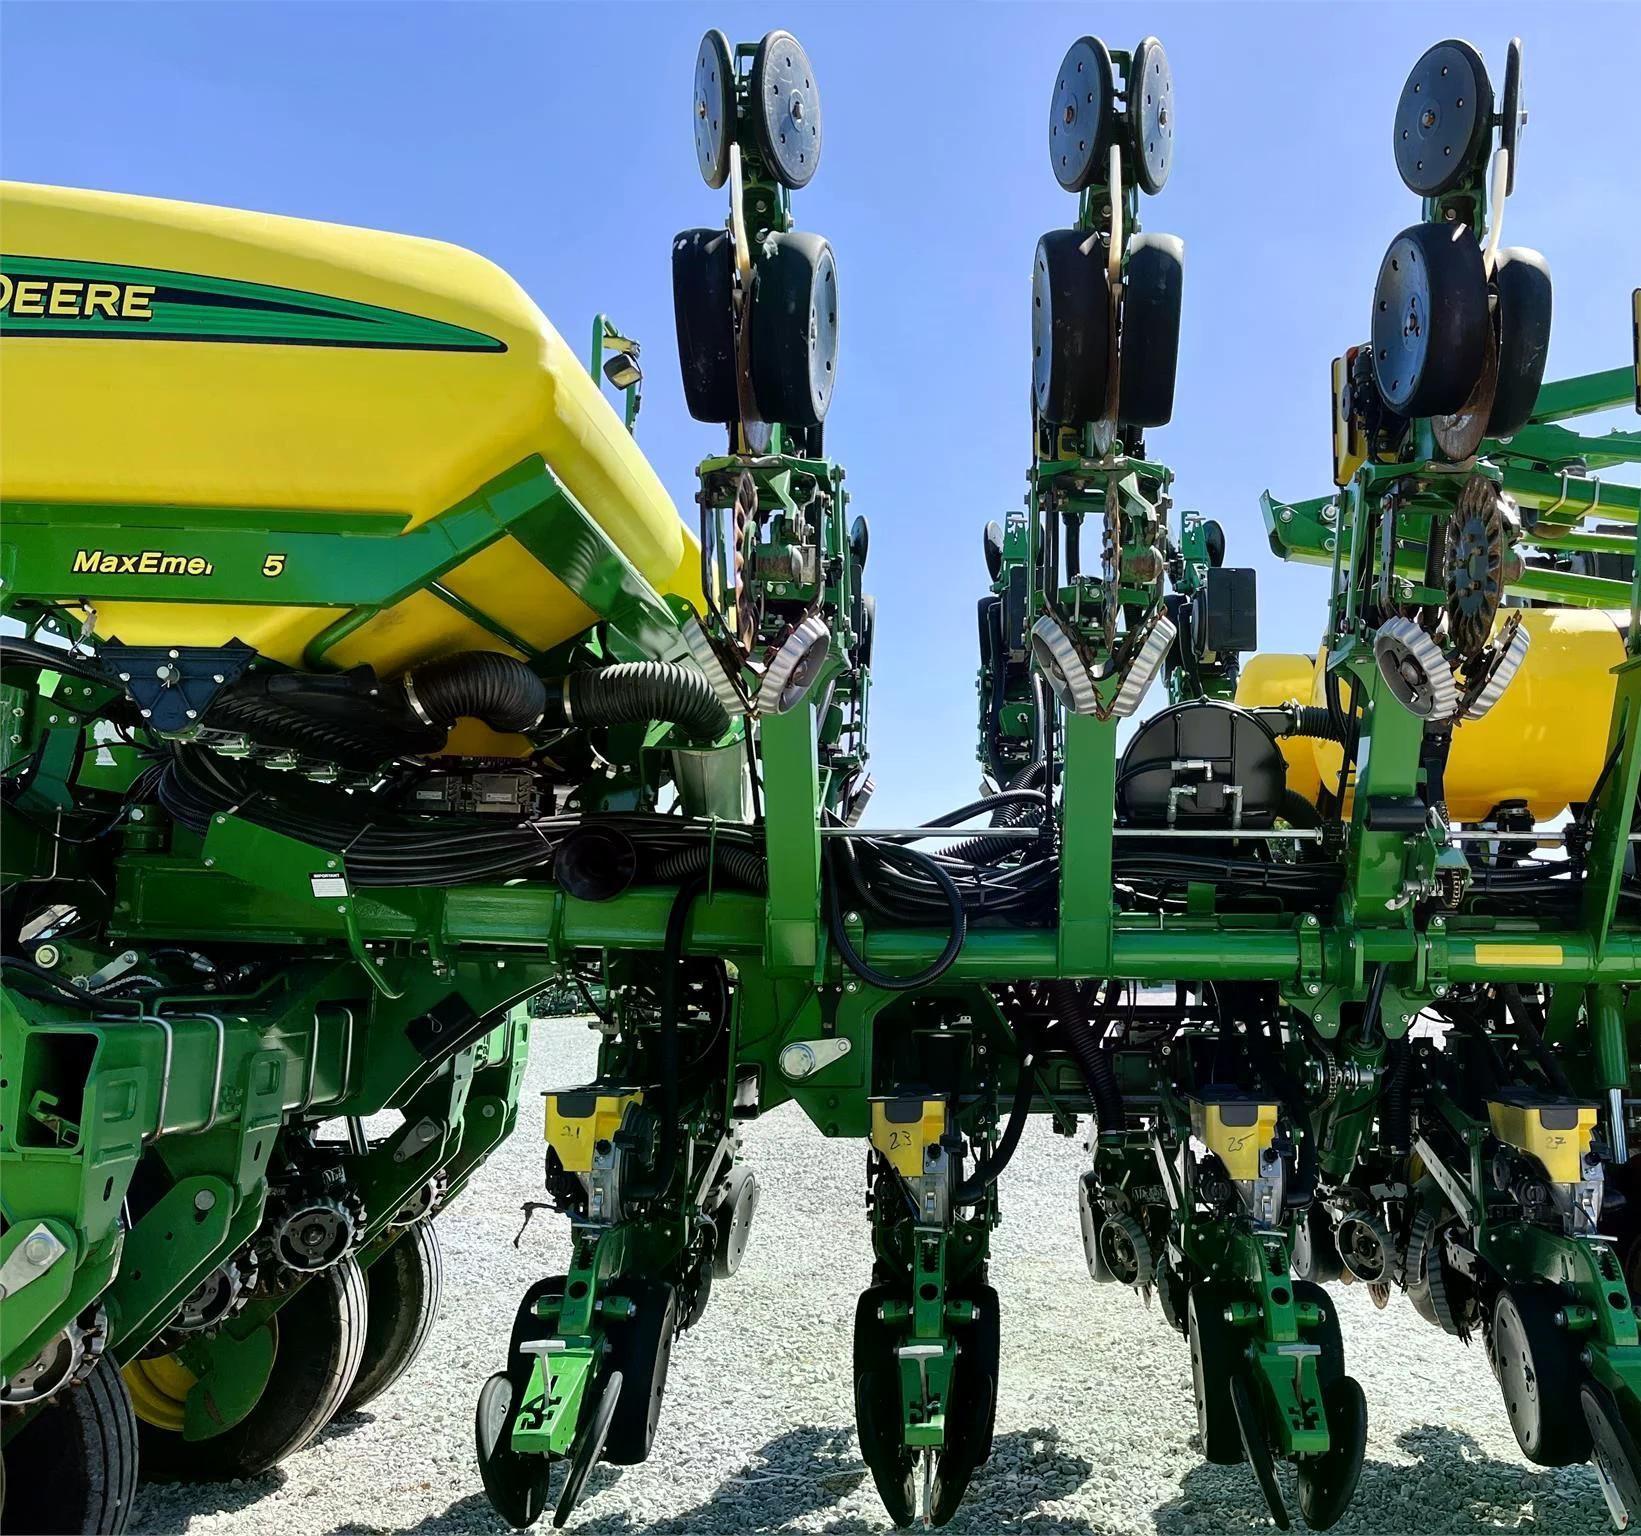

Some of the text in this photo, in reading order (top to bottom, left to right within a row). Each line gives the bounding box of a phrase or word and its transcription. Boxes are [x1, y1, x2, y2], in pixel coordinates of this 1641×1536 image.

[262, 554, 286, 577] 5
[889, 1130, 912, 1150] 23
[1228, 1133, 1255, 1152] 25
